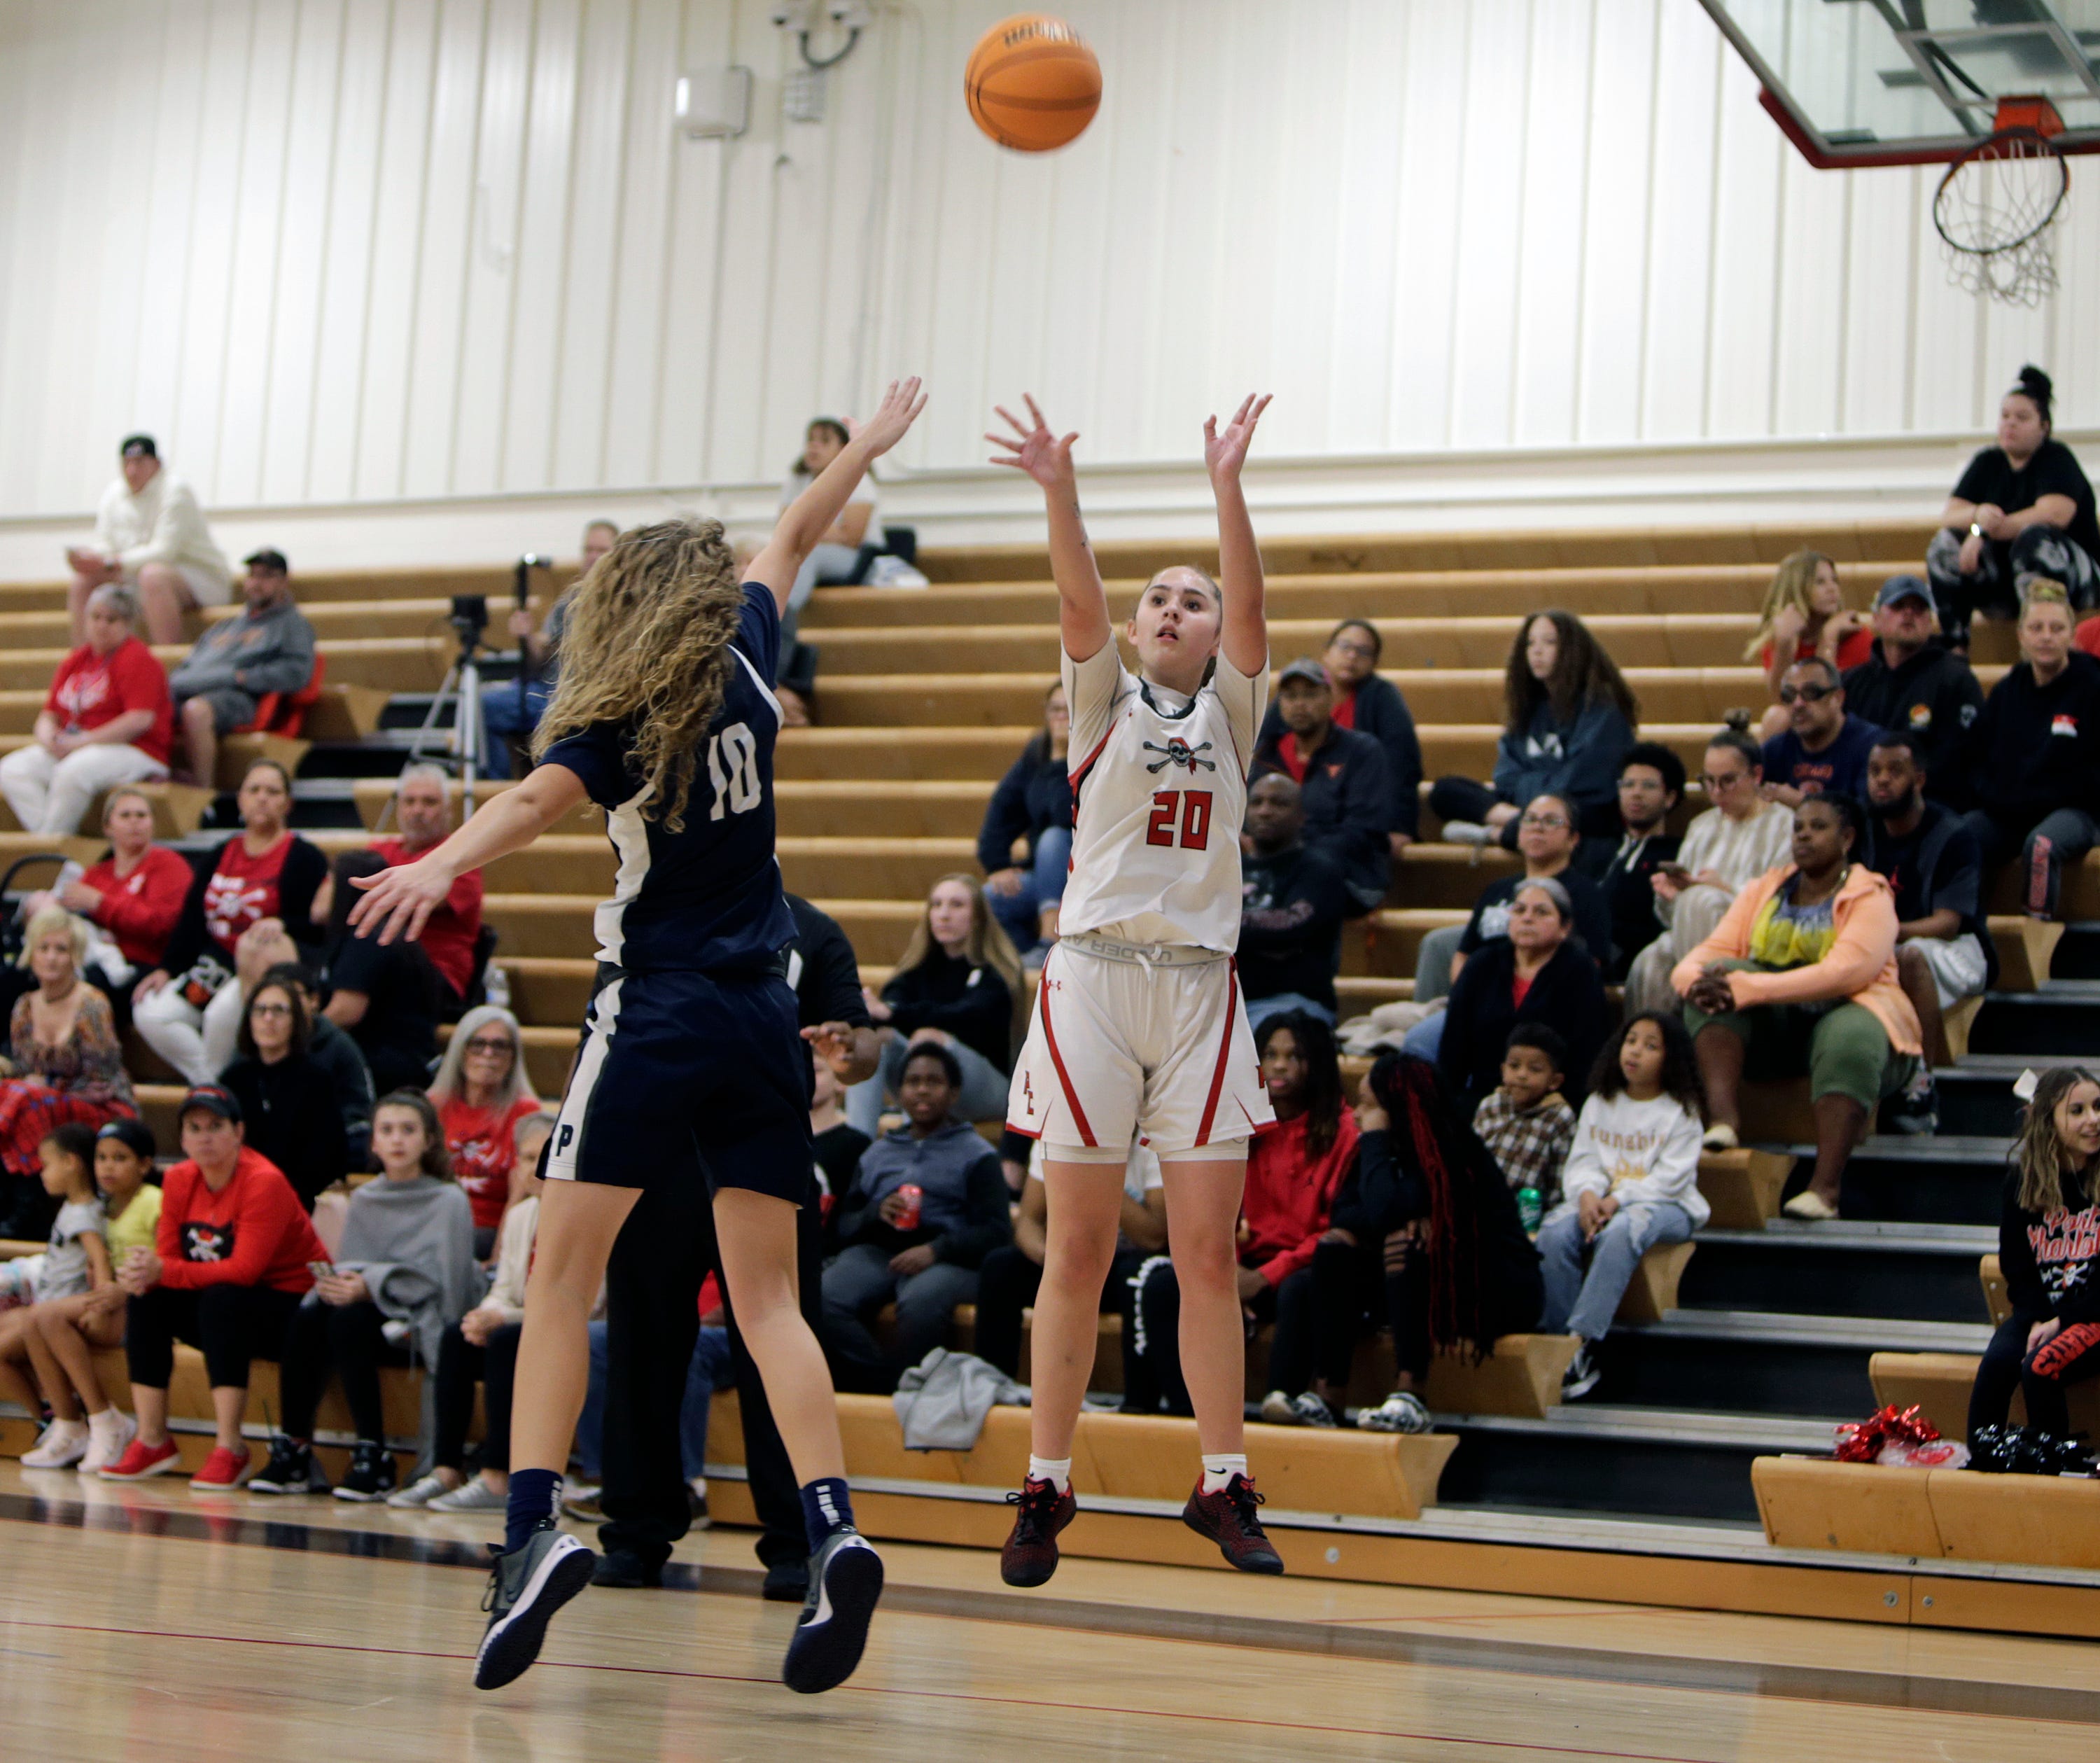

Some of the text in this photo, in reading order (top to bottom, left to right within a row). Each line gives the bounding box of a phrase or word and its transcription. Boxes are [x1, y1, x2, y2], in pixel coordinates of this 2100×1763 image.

[708, 722, 762, 821] 10
[1147, 790, 1213, 851] 20
[556, 1124, 574, 1157] P
